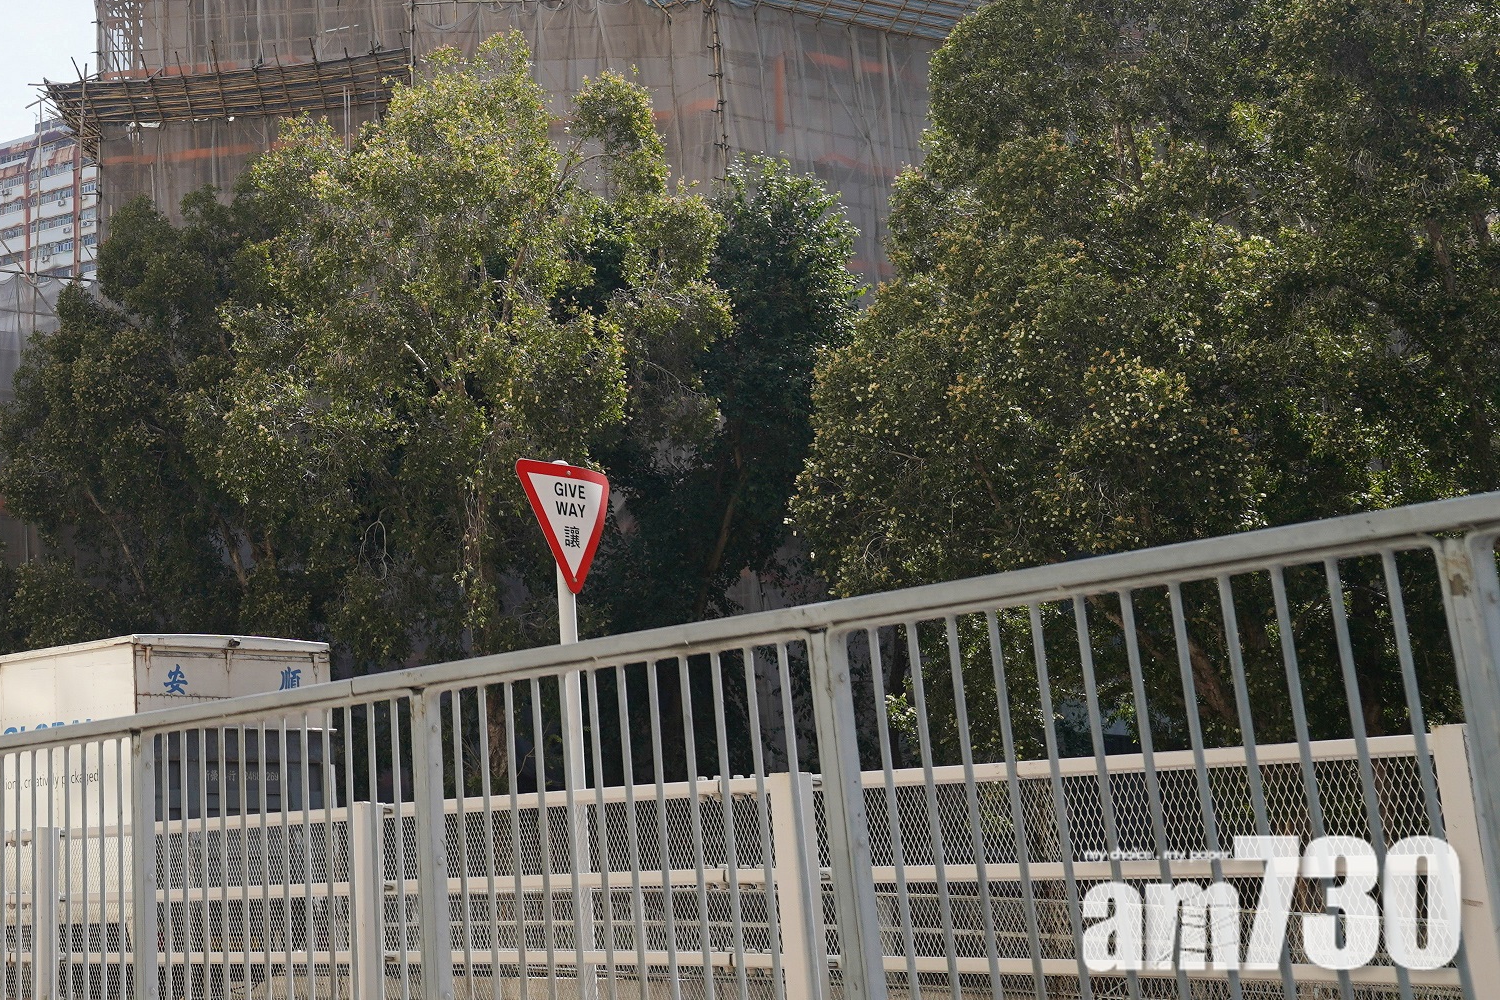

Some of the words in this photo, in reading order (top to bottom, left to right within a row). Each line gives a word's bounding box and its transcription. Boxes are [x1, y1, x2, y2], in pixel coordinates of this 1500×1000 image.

[554, 482, 586, 499] GIVE
[555, 501, 586, 518] WAY
[563, 525, 581, 548] 讓
